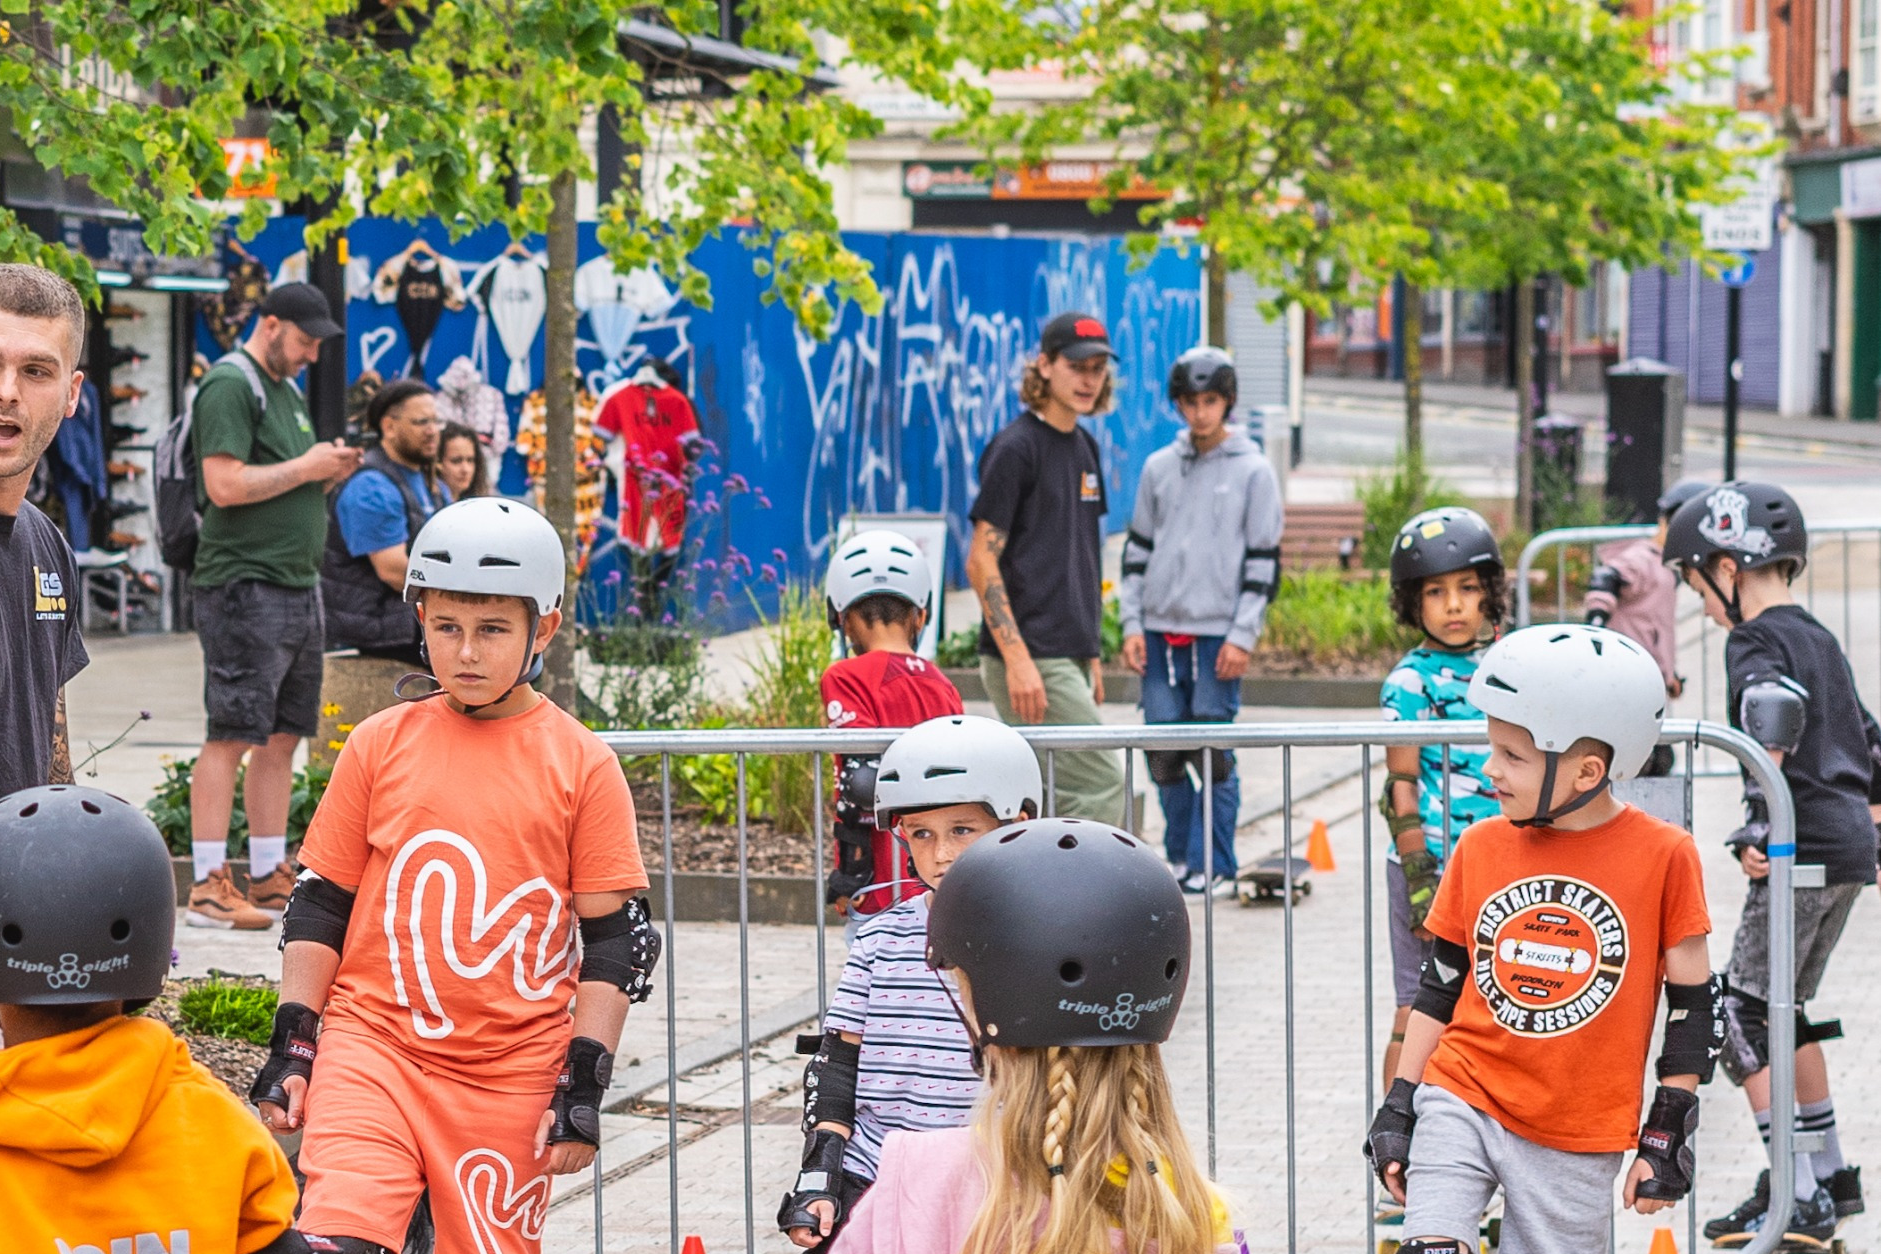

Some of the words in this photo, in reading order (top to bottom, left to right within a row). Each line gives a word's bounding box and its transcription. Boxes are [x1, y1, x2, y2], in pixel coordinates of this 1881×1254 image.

[1478, 880, 1556, 939] DISTRICT
[1560, 883, 1624, 959] SKATERS
[6, 956, 55, 973] triple
[82, 953, 129, 973] eight
[1058, 998, 1110, 1015] triple
[1533, 976, 1614, 1033] SESSIONS
